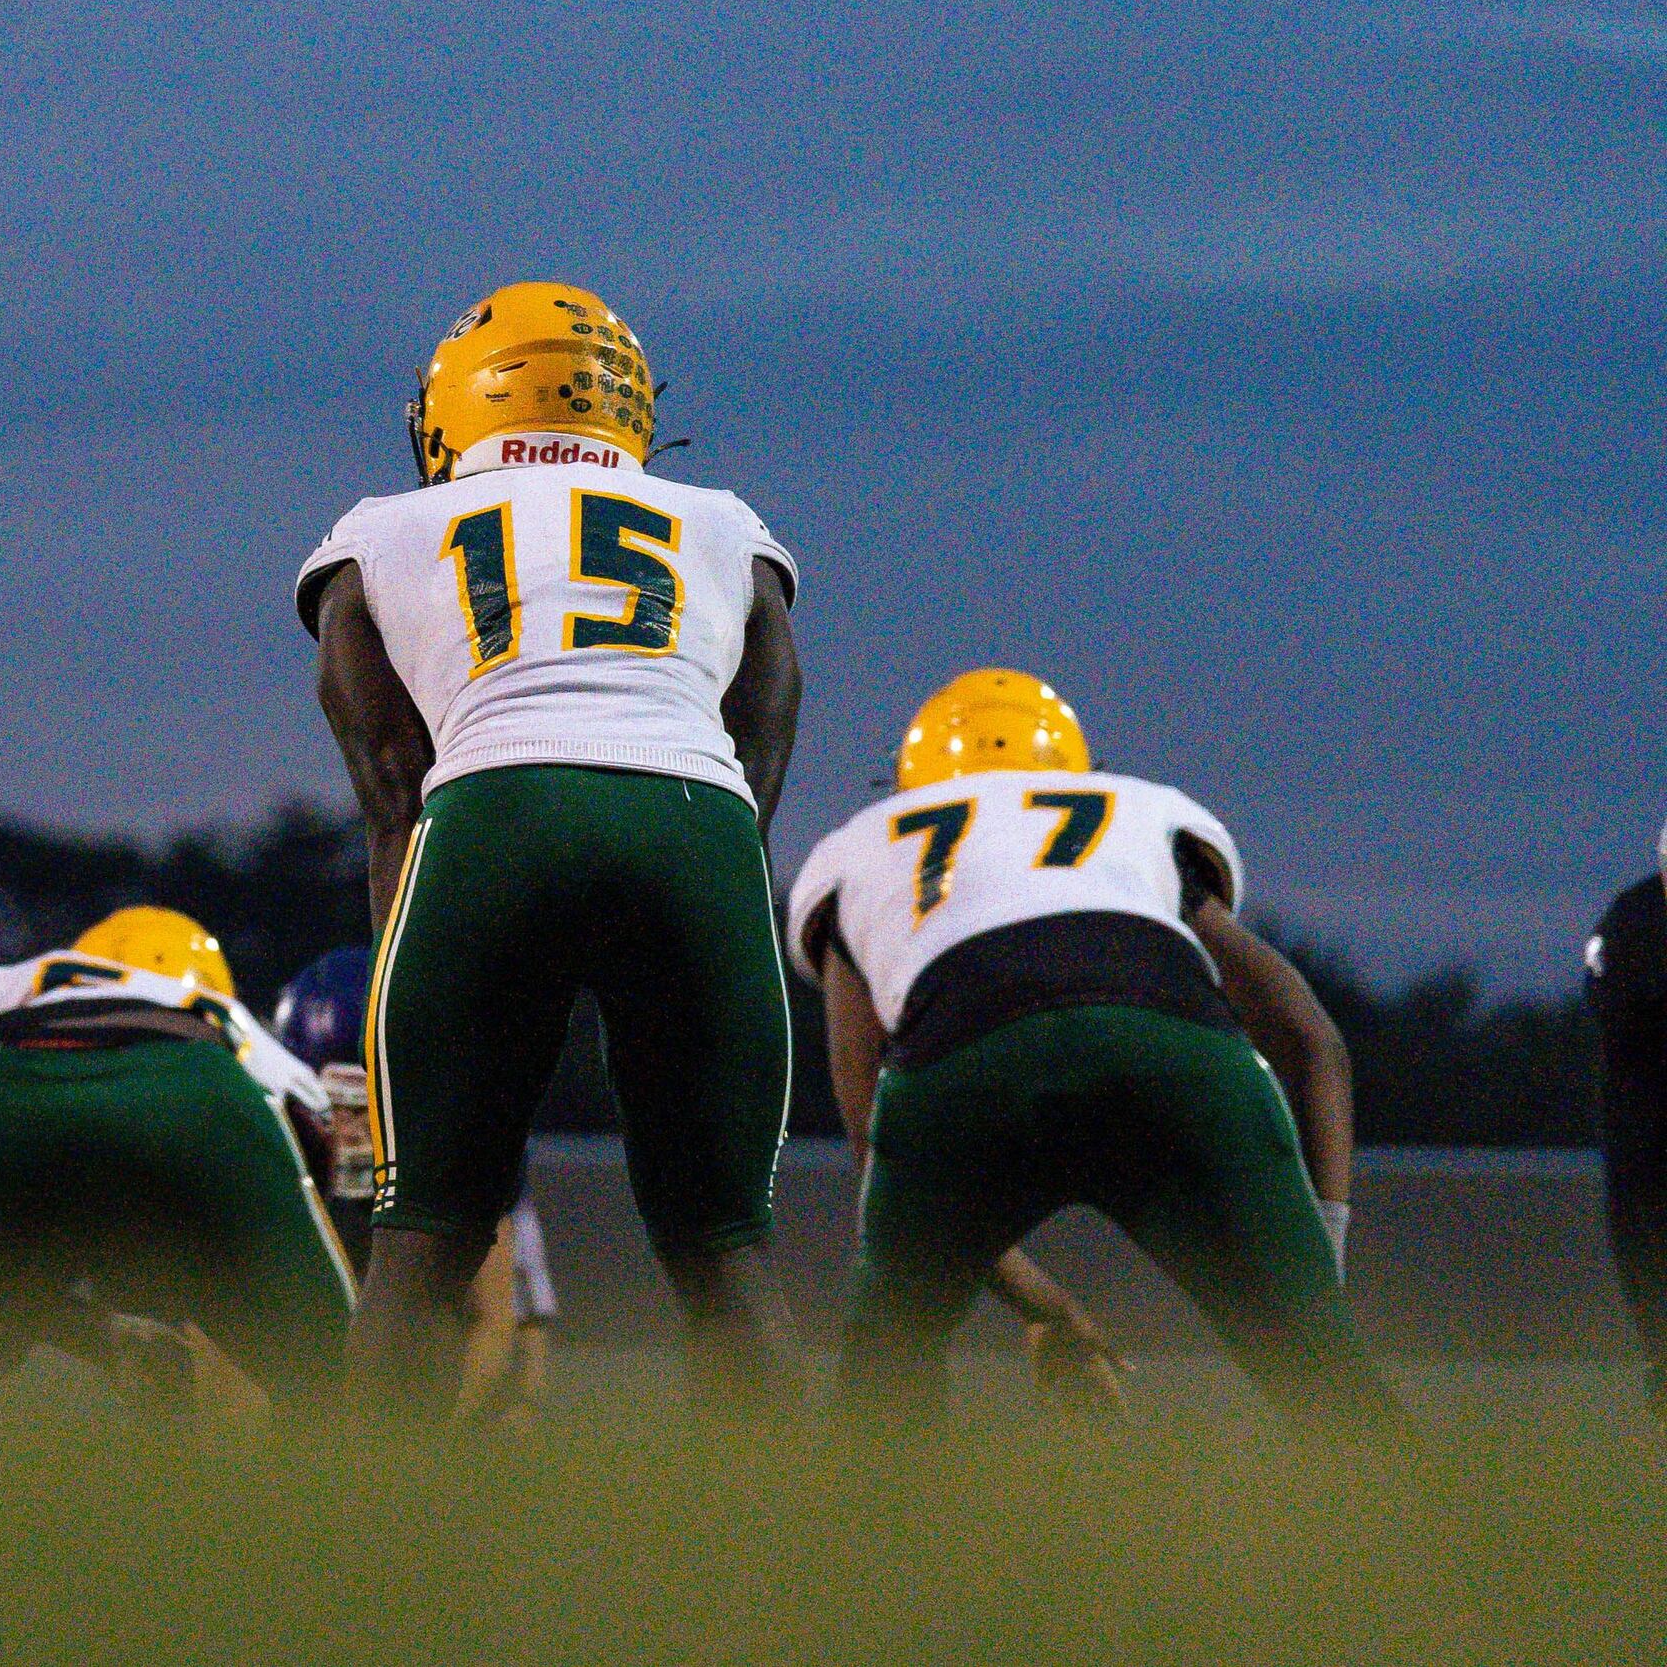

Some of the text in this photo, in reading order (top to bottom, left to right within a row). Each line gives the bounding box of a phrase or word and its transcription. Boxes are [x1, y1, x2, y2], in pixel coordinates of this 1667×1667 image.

[502, 440, 619, 469] Riddell
[436, 487, 685, 681] 15
[886, 788, 1117, 934] 77
